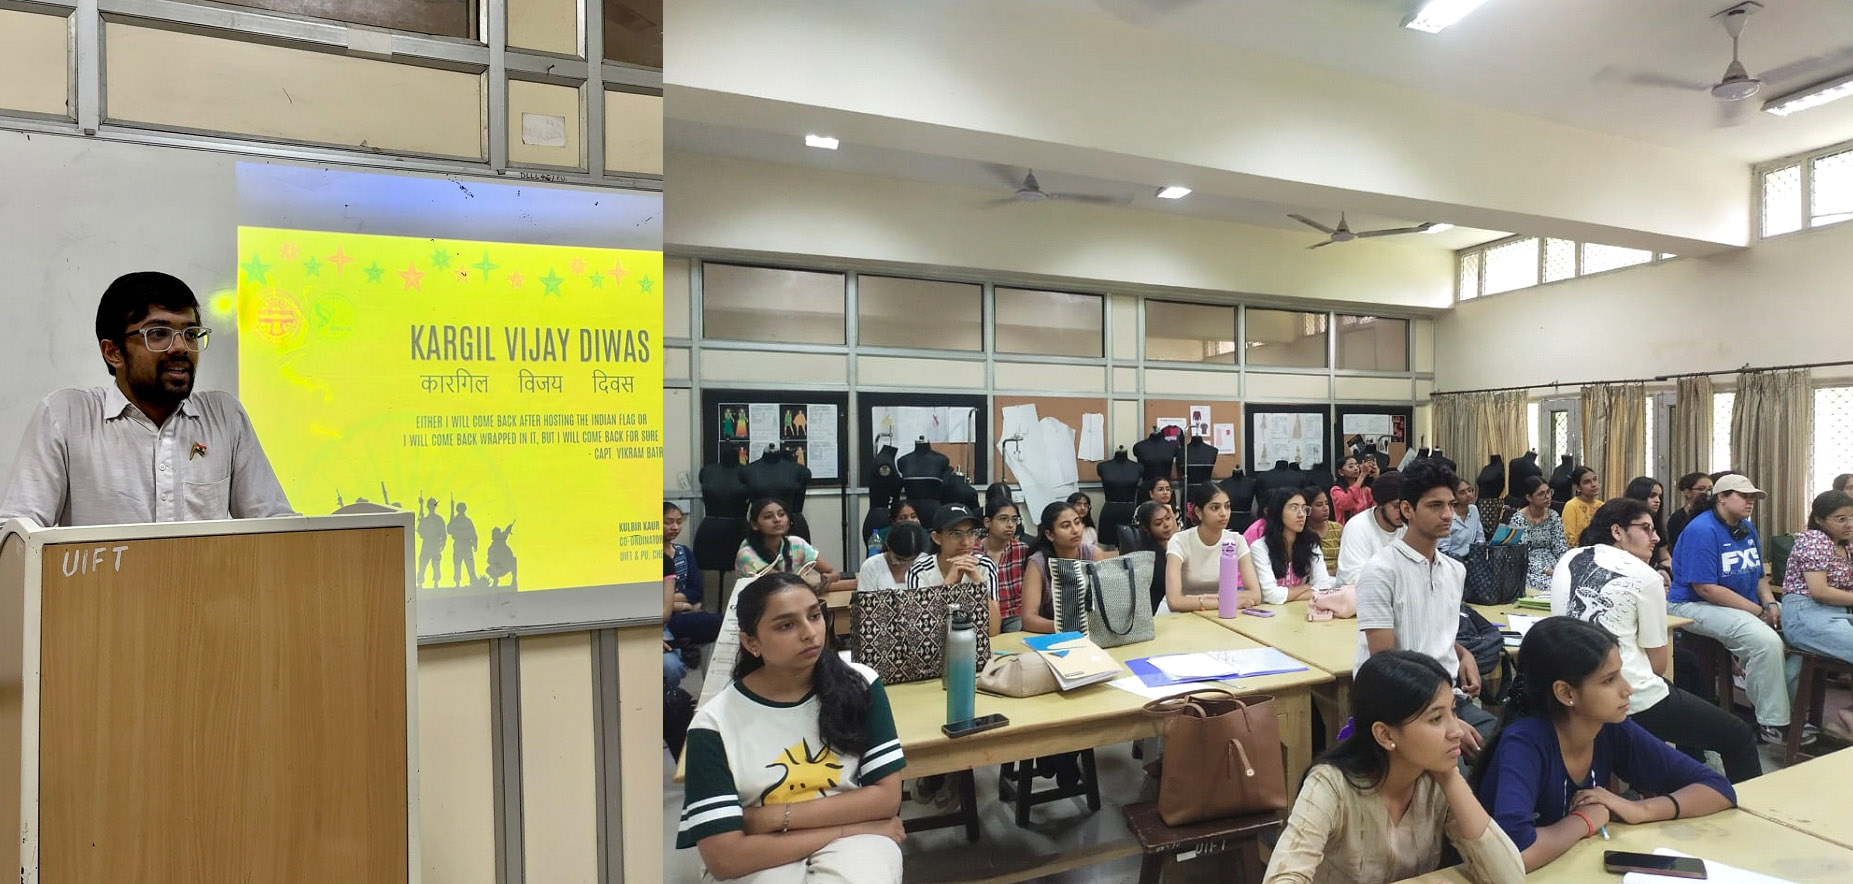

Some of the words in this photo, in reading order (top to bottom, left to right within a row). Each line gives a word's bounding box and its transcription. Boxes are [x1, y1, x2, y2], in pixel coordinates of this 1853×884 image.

[410, 324, 496, 361] KARGIL
[504, 326, 570, 362] VIJAY
[579, 328, 650, 363] DIWAS
[420, 367, 490, 394] कारगिल
[518, 368, 564, 394] विजय
[592, 368, 635, 395] दिवस
[416, 415, 443, 429] EITHER
[445, 415, 449, 428] I
[451, 415, 470, 428] WILL
[472, 414, 494, 428] COME
[497, 414, 517, 427] BACK
[519, 414, 541, 427] AFTER
[543, 413, 574, 427] HOSTING
[576, 413, 589, 426] THE
[591, 413, 617, 426] INDIAN
[619, 413, 636, 425] FLAG
[637, 413, 648, 425] OR
[403, 434, 407, 447] I
[409, 433, 429, 447] WILL
[431, 433, 454, 447] COME
[456, 432, 478, 446] BACK
[480, 432, 517, 445] WRAPPED
[519, 431, 528, 445] IN
[541, 431, 555, 444] BUT
[562, 431, 580, 444] WILL
[582, 430, 602, 443] COME
[605, 430, 624, 443] BACK
[625, 430, 639, 442] FOR
[641, 430, 659, 442] SURE
[616, 447, 645, 460] VIKRAM
[618, 521, 642, 533] KULBIR
[643, 520, 660, 531] KAUR
[62, 545, 129, 577] UIFT
[634, 551, 639, 561] &
